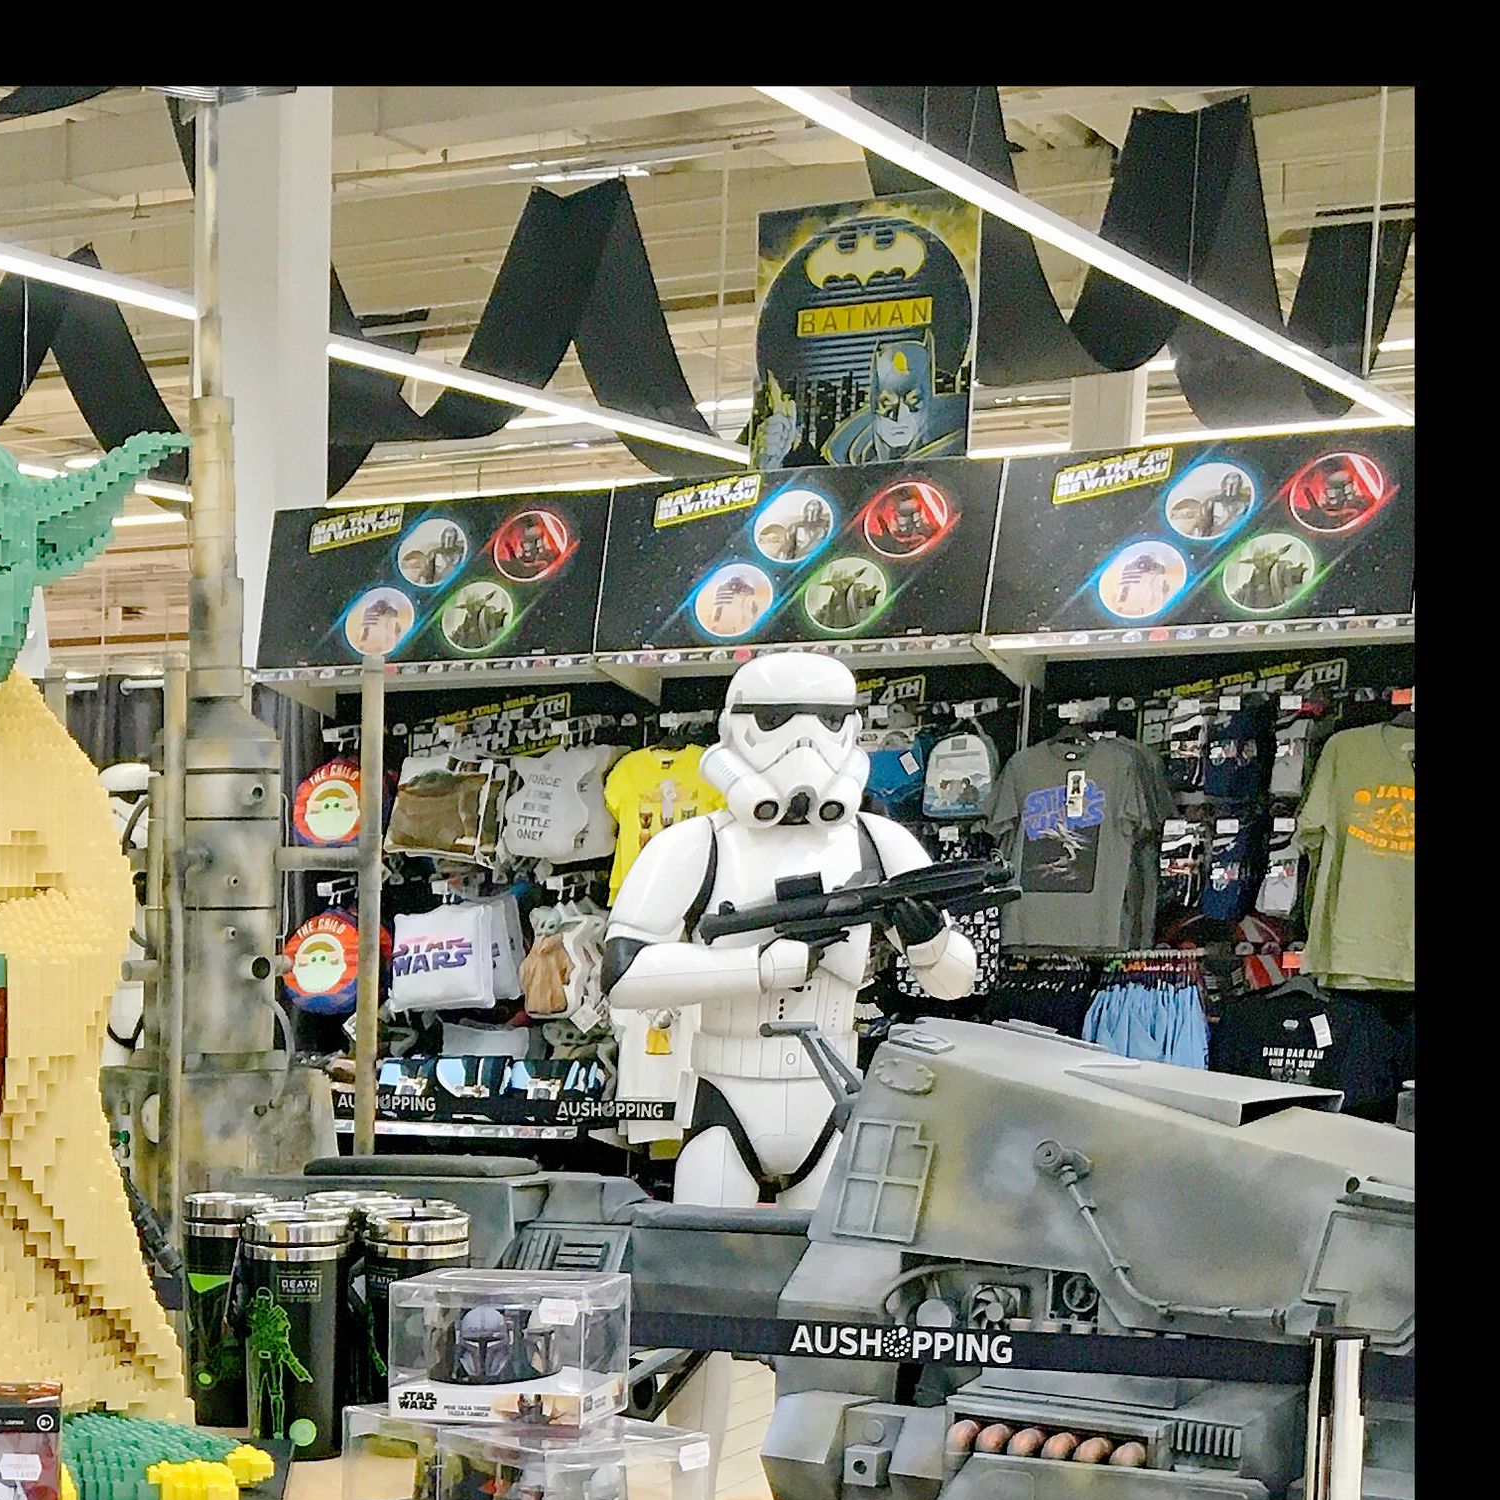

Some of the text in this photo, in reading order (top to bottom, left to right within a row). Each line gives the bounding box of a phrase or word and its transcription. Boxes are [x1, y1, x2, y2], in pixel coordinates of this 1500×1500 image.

[801, 303, 931, 333] BATMAN
[1057, 461, 1169, 496] BE WITH YOU
[1059, 465, 1098, 482] MAY
[1101, 459, 1134, 478] THE
[658, 490, 757, 520] BE WITH YOU
[660, 493, 696, 511] MAY
[698, 486, 729, 504] THE
[1260, 660, 1300, 678] WARS
[1294, 664, 1341, 691] 4TH
[878, 680, 921, 704] 4TH
[530, 697, 565, 719] 4TH
[308, 764, 360, 786] THE CHILD
[511, 814, 551, 829] LITTLE
[296, 918, 347, 938] THE CHILD
[392, 950, 474, 976] WARS
[558, 1099, 664, 1118] AUSHOPPING
[281, 1279, 317, 1288] DEATH
[790, 1326, 1013, 1364] AUSHOPPING
[398, 1391, 437, 1402] STAR
[398, 1400, 437, 1411] WARS
